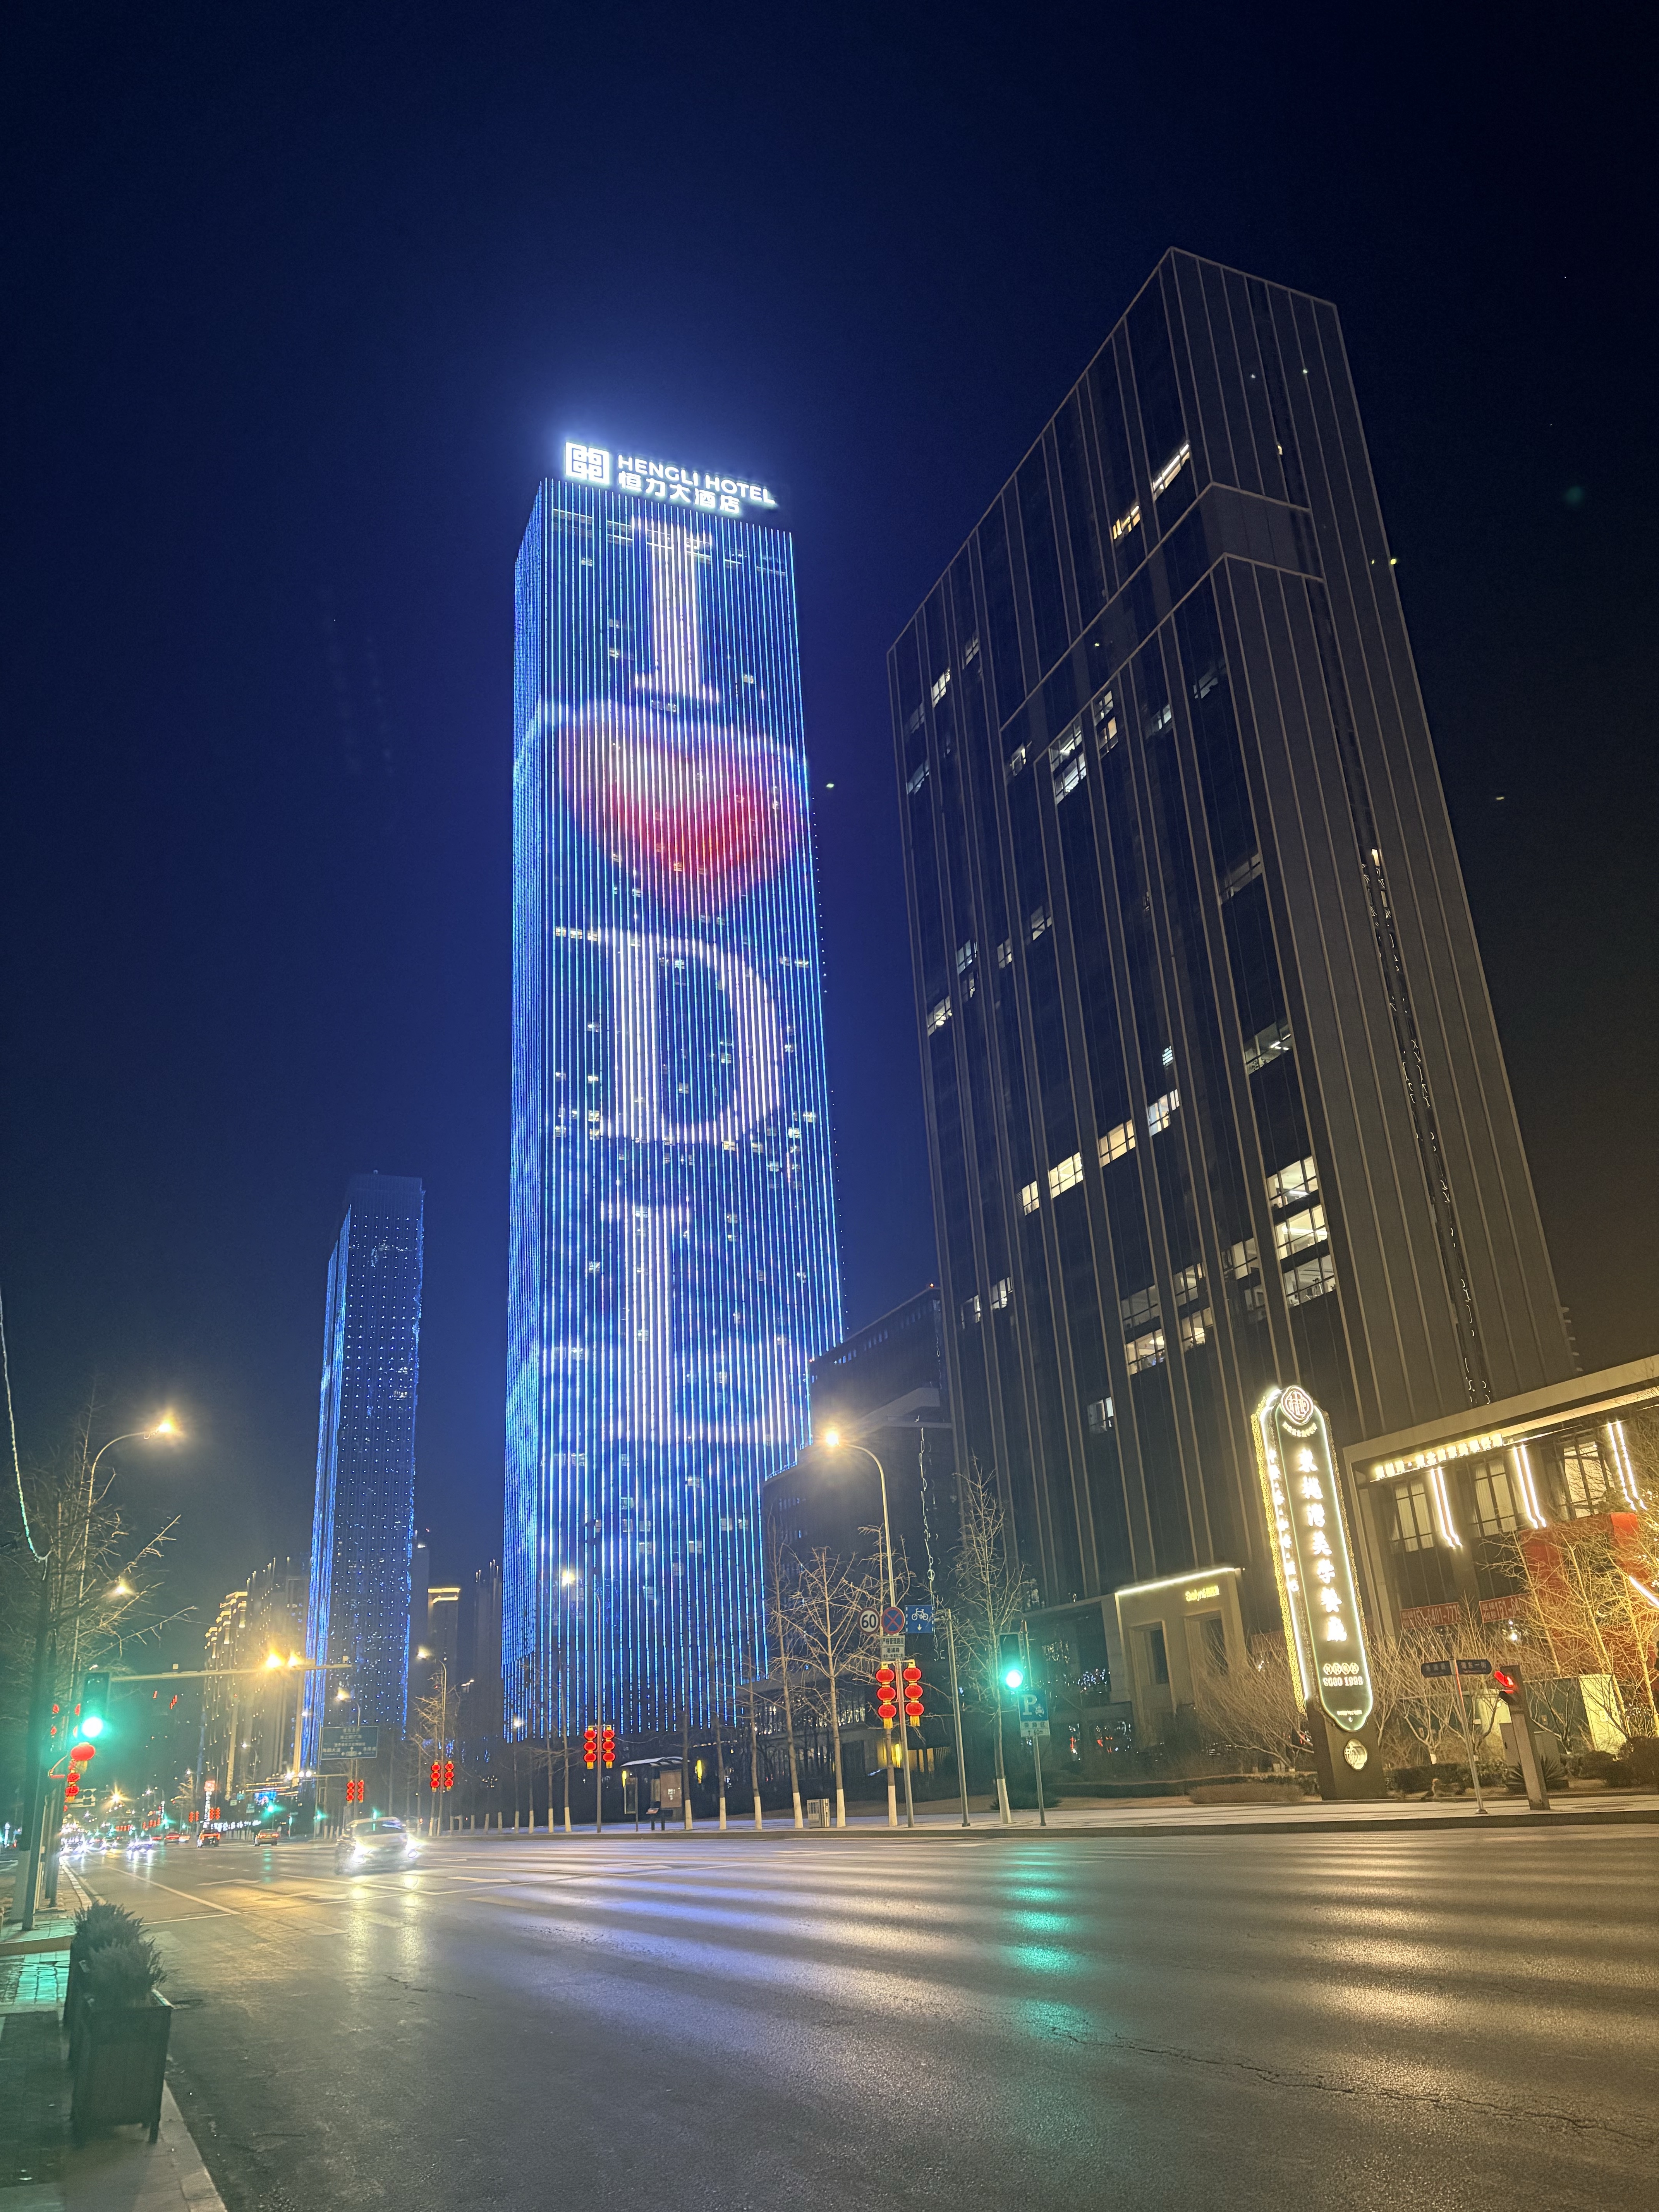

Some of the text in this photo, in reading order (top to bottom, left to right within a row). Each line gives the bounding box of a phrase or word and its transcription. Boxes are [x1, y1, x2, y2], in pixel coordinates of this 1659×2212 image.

[618, 455, 776, 505] HENGLI HOTEL
[618, 471, 740, 514] 恒力大酒店
[861, 1614, 877, 1628] 60
[1022, 1694, 1037, 1716] P
